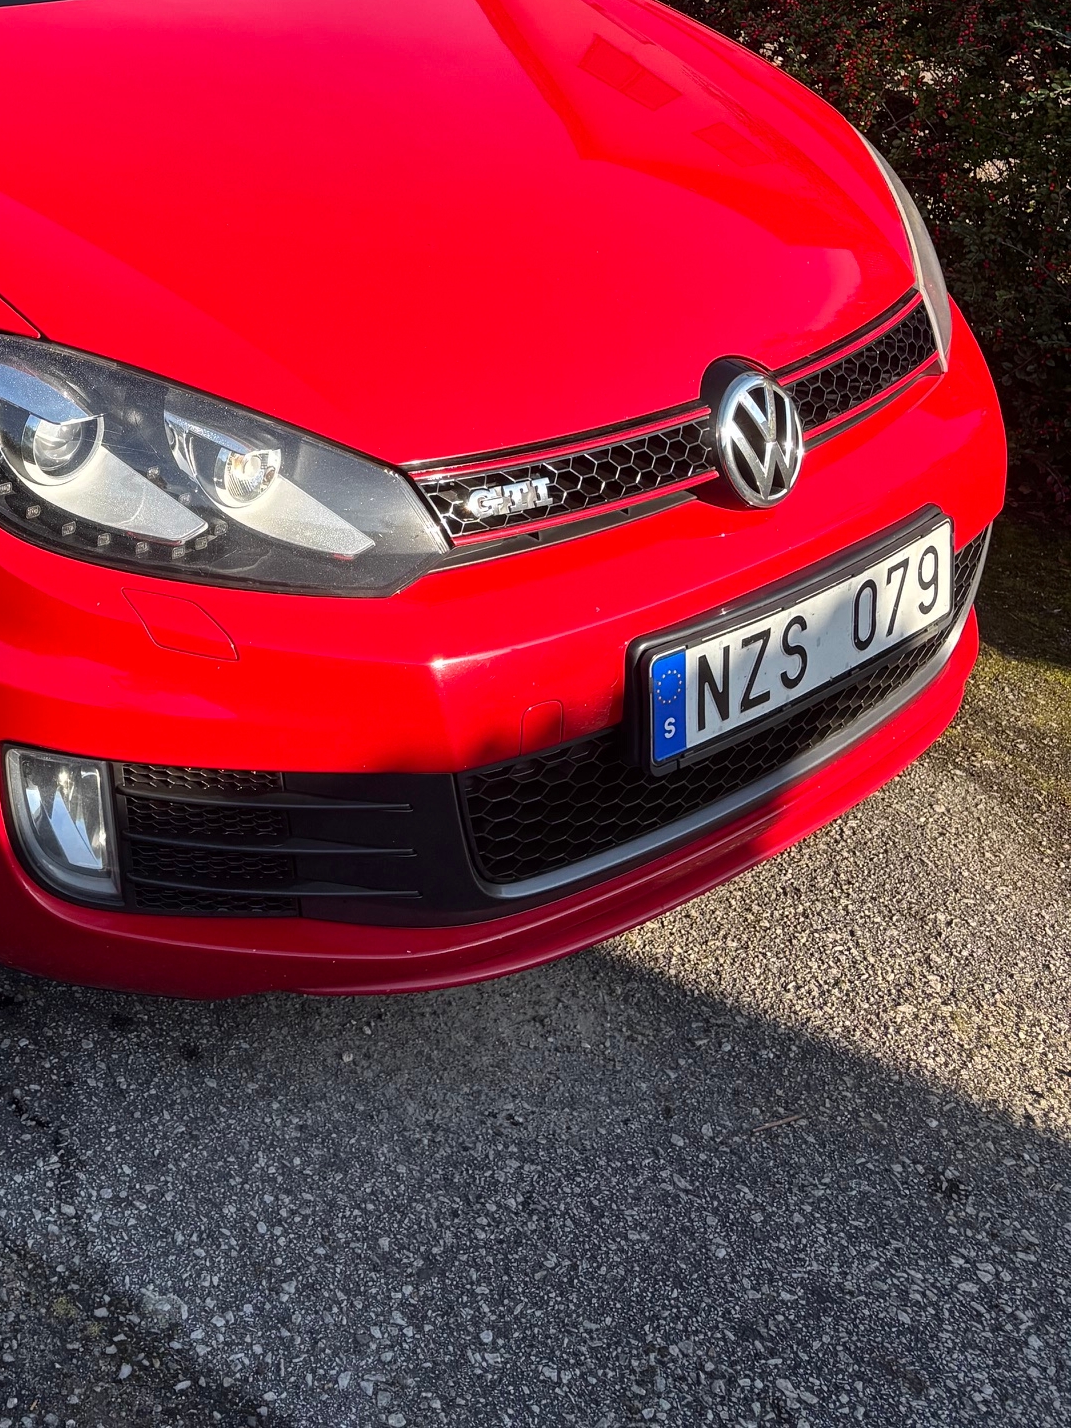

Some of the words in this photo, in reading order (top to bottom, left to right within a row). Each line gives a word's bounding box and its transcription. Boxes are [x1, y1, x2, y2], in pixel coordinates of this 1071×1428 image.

[469, 477, 553, 519] GTI
[697, 615, 808, 732] NZS
[852, 545, 939, 652] 079
[663, 717, 676, 739] S
